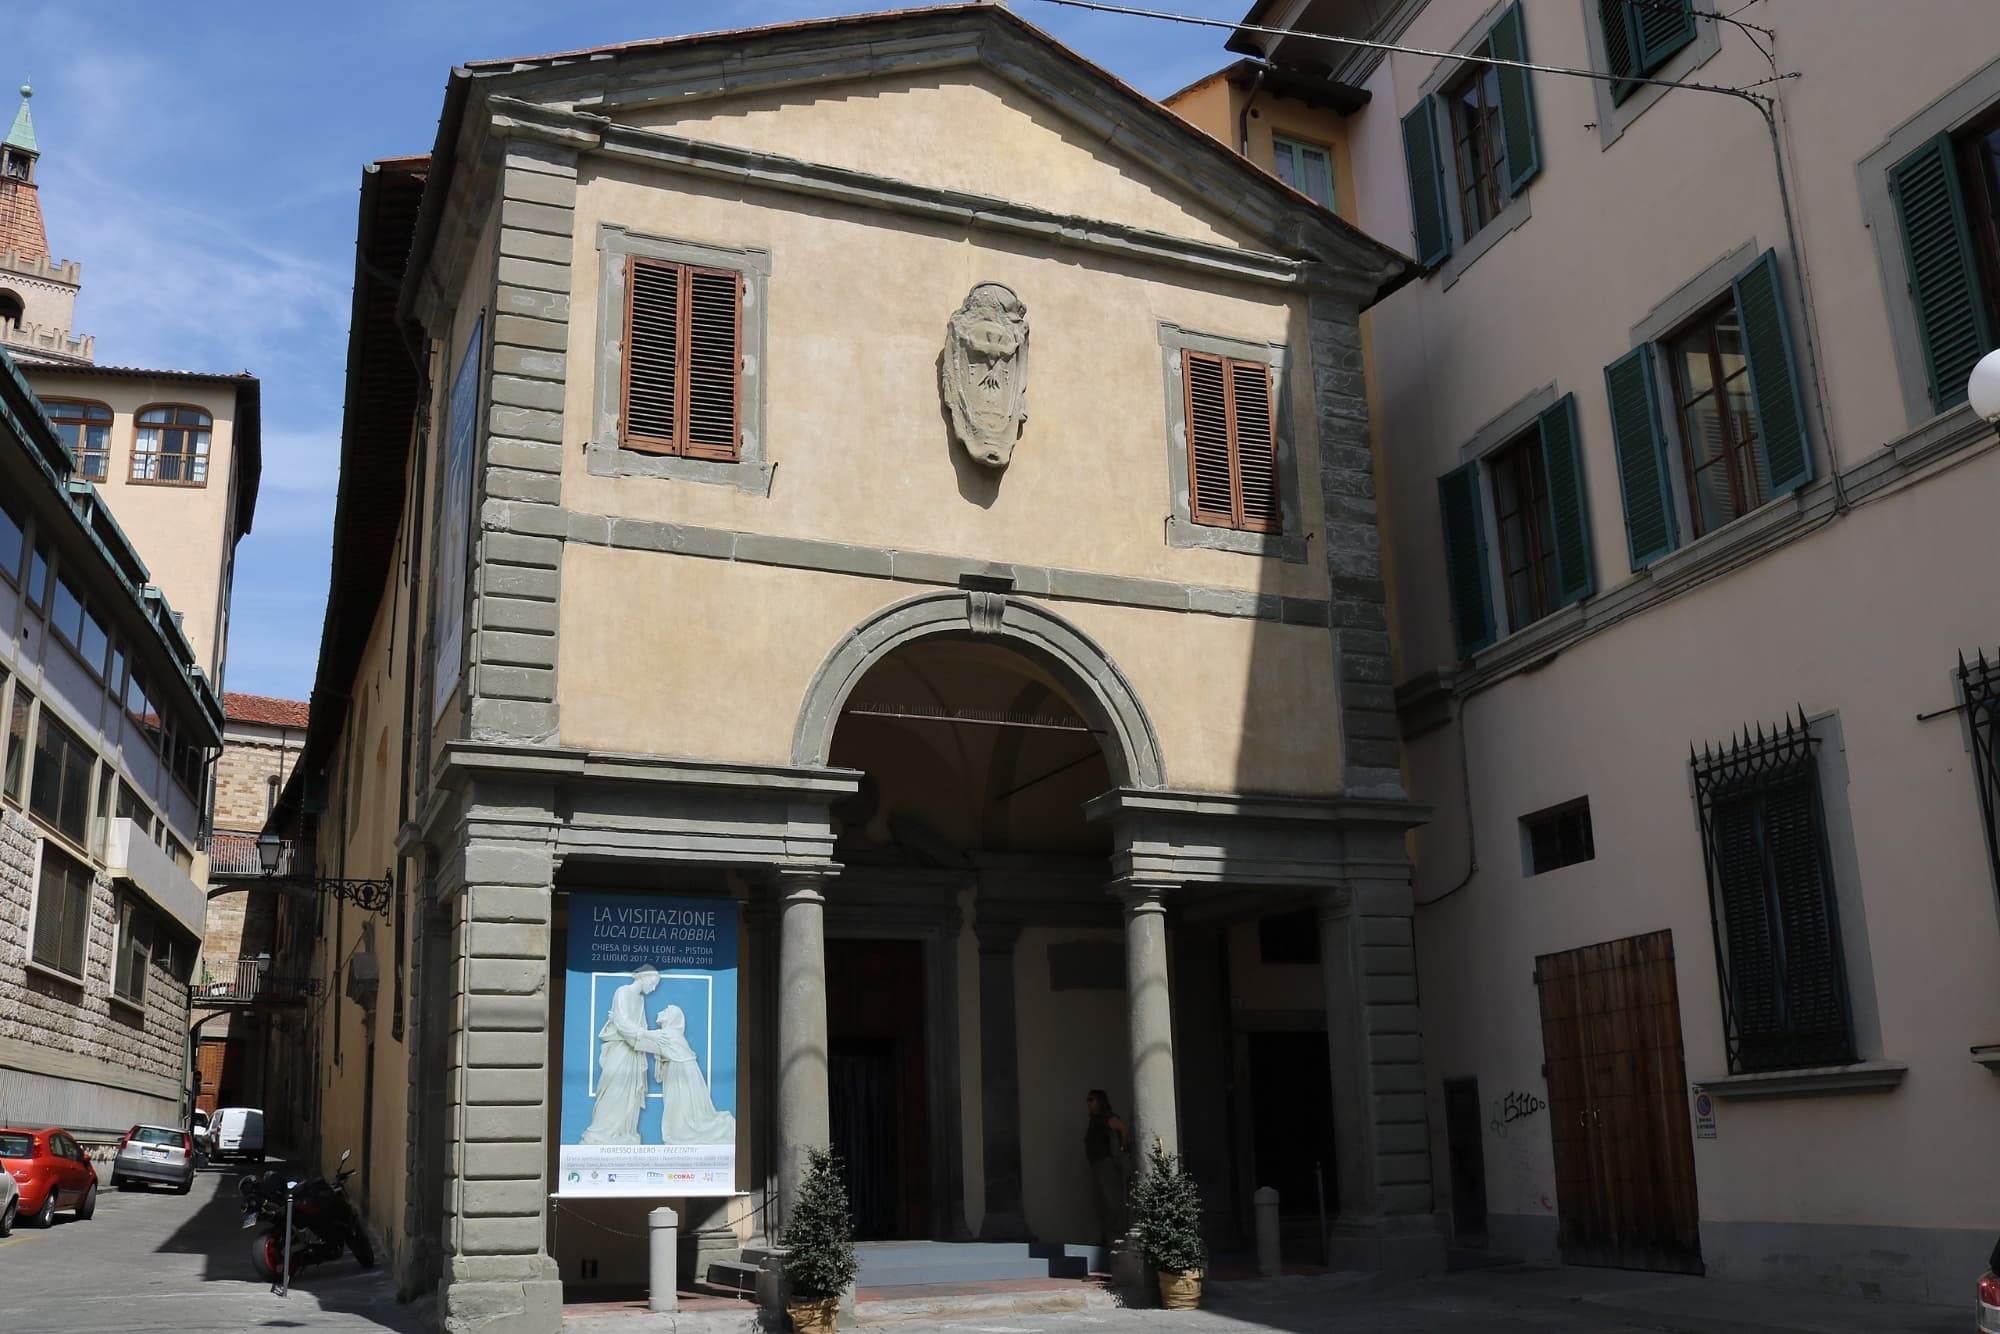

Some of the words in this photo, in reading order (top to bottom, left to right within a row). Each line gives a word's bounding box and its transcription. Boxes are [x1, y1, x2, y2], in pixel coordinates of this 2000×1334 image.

[593, 906, 612, 922] LA
[618, 907, 716, 927] VISITAZIONE
[593, 924, 627, 938] LUCA
[630, 926, 667, 940] DELLA
[670, 927, 716, 942] ROBBIA
[591, 943, 620, 952] CHIESA
[622, 944, 630, 952] DI
[633, 945, 649, 953] SAN
[652, 945, 676, 954] LEONE
[685, 946, 713, 955] PISTOIA
[591, 953, 601, 961] 22
[603, 954, 628, 962] LUGLIO
[661, 956, 694, 964] GENNAIO
